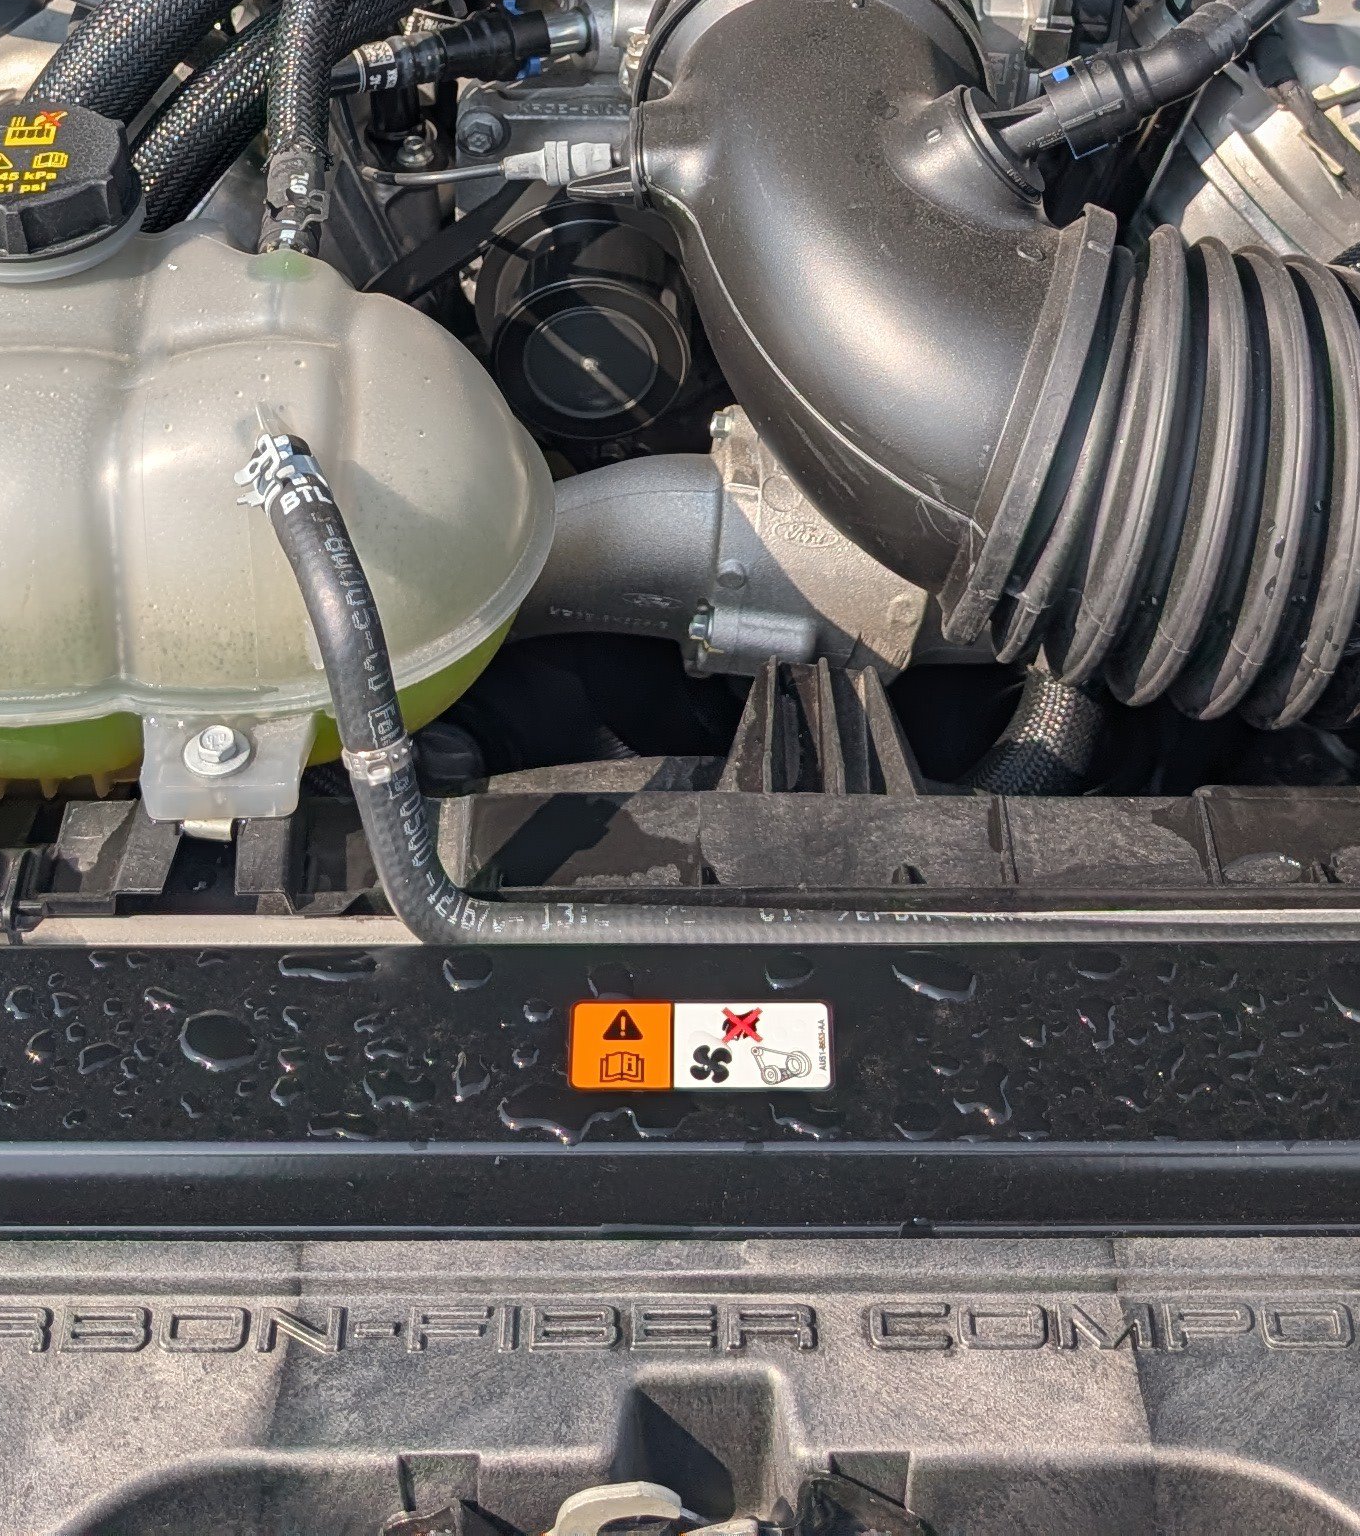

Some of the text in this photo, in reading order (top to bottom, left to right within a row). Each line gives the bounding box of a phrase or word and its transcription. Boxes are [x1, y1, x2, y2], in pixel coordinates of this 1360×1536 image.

[23, 170, 57, 181] kPa
[19, 182, 47, 194] psi
[278, 481, 333, 517] BTL
